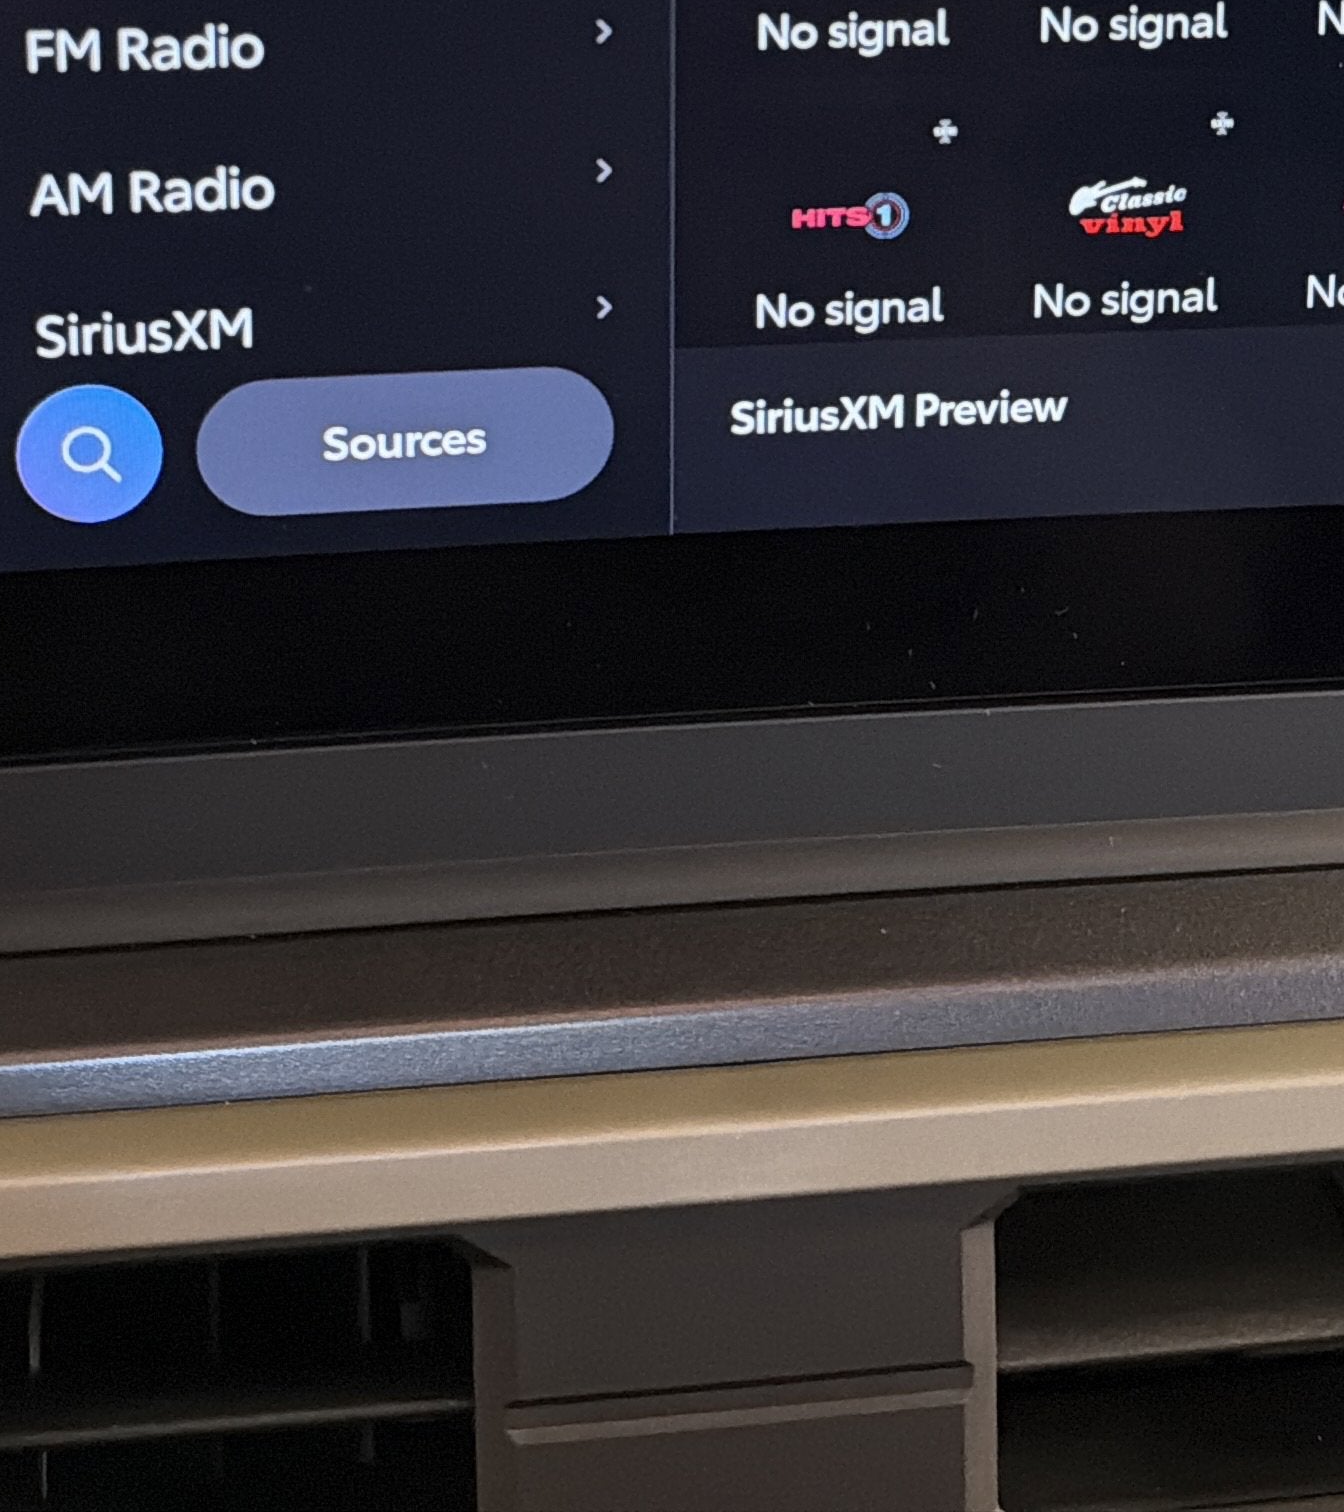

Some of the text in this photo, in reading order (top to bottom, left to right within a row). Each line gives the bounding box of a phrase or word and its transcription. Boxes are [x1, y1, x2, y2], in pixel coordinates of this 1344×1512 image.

[25, 22, 266, 74] FM Radio
[756, 7, 951, 58] No signal
[1039, 0, 1229, 50] No signal
[29, 164, 276, 217] AM Radio
[1079, 210, 1184, 238] vinyl
[755, 285, 945, 335] No signal
[1032, 276, 1218, 324] No signal
[34, 307, 254, 359] SiriusXM
[729, 388, 1069, 436] SiriusXM Preview
[322, 426, 488, 462] Sources
